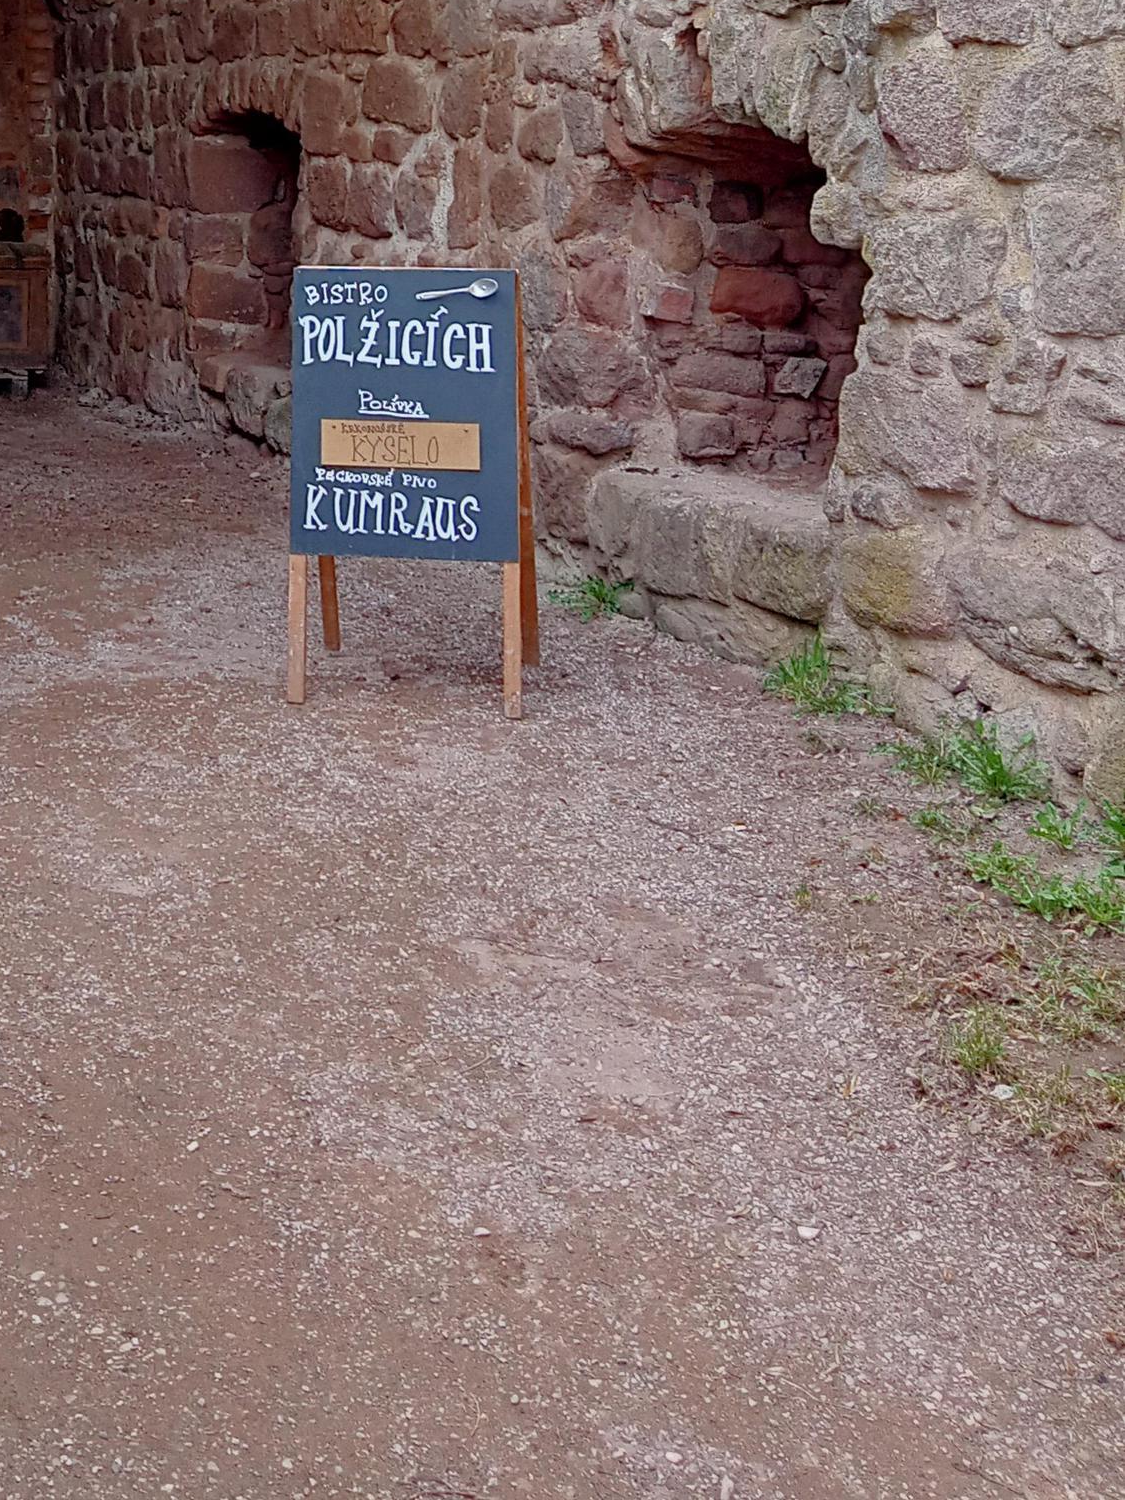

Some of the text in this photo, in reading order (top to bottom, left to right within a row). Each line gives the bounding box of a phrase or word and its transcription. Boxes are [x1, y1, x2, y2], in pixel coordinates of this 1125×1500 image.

[303, 281, 389, 306] BISTRO
[351, 434, 440, 466] KYSELO
[401, 473, 438, 489] PIVO
[303, 483, 481, 542] KUMRAUS
